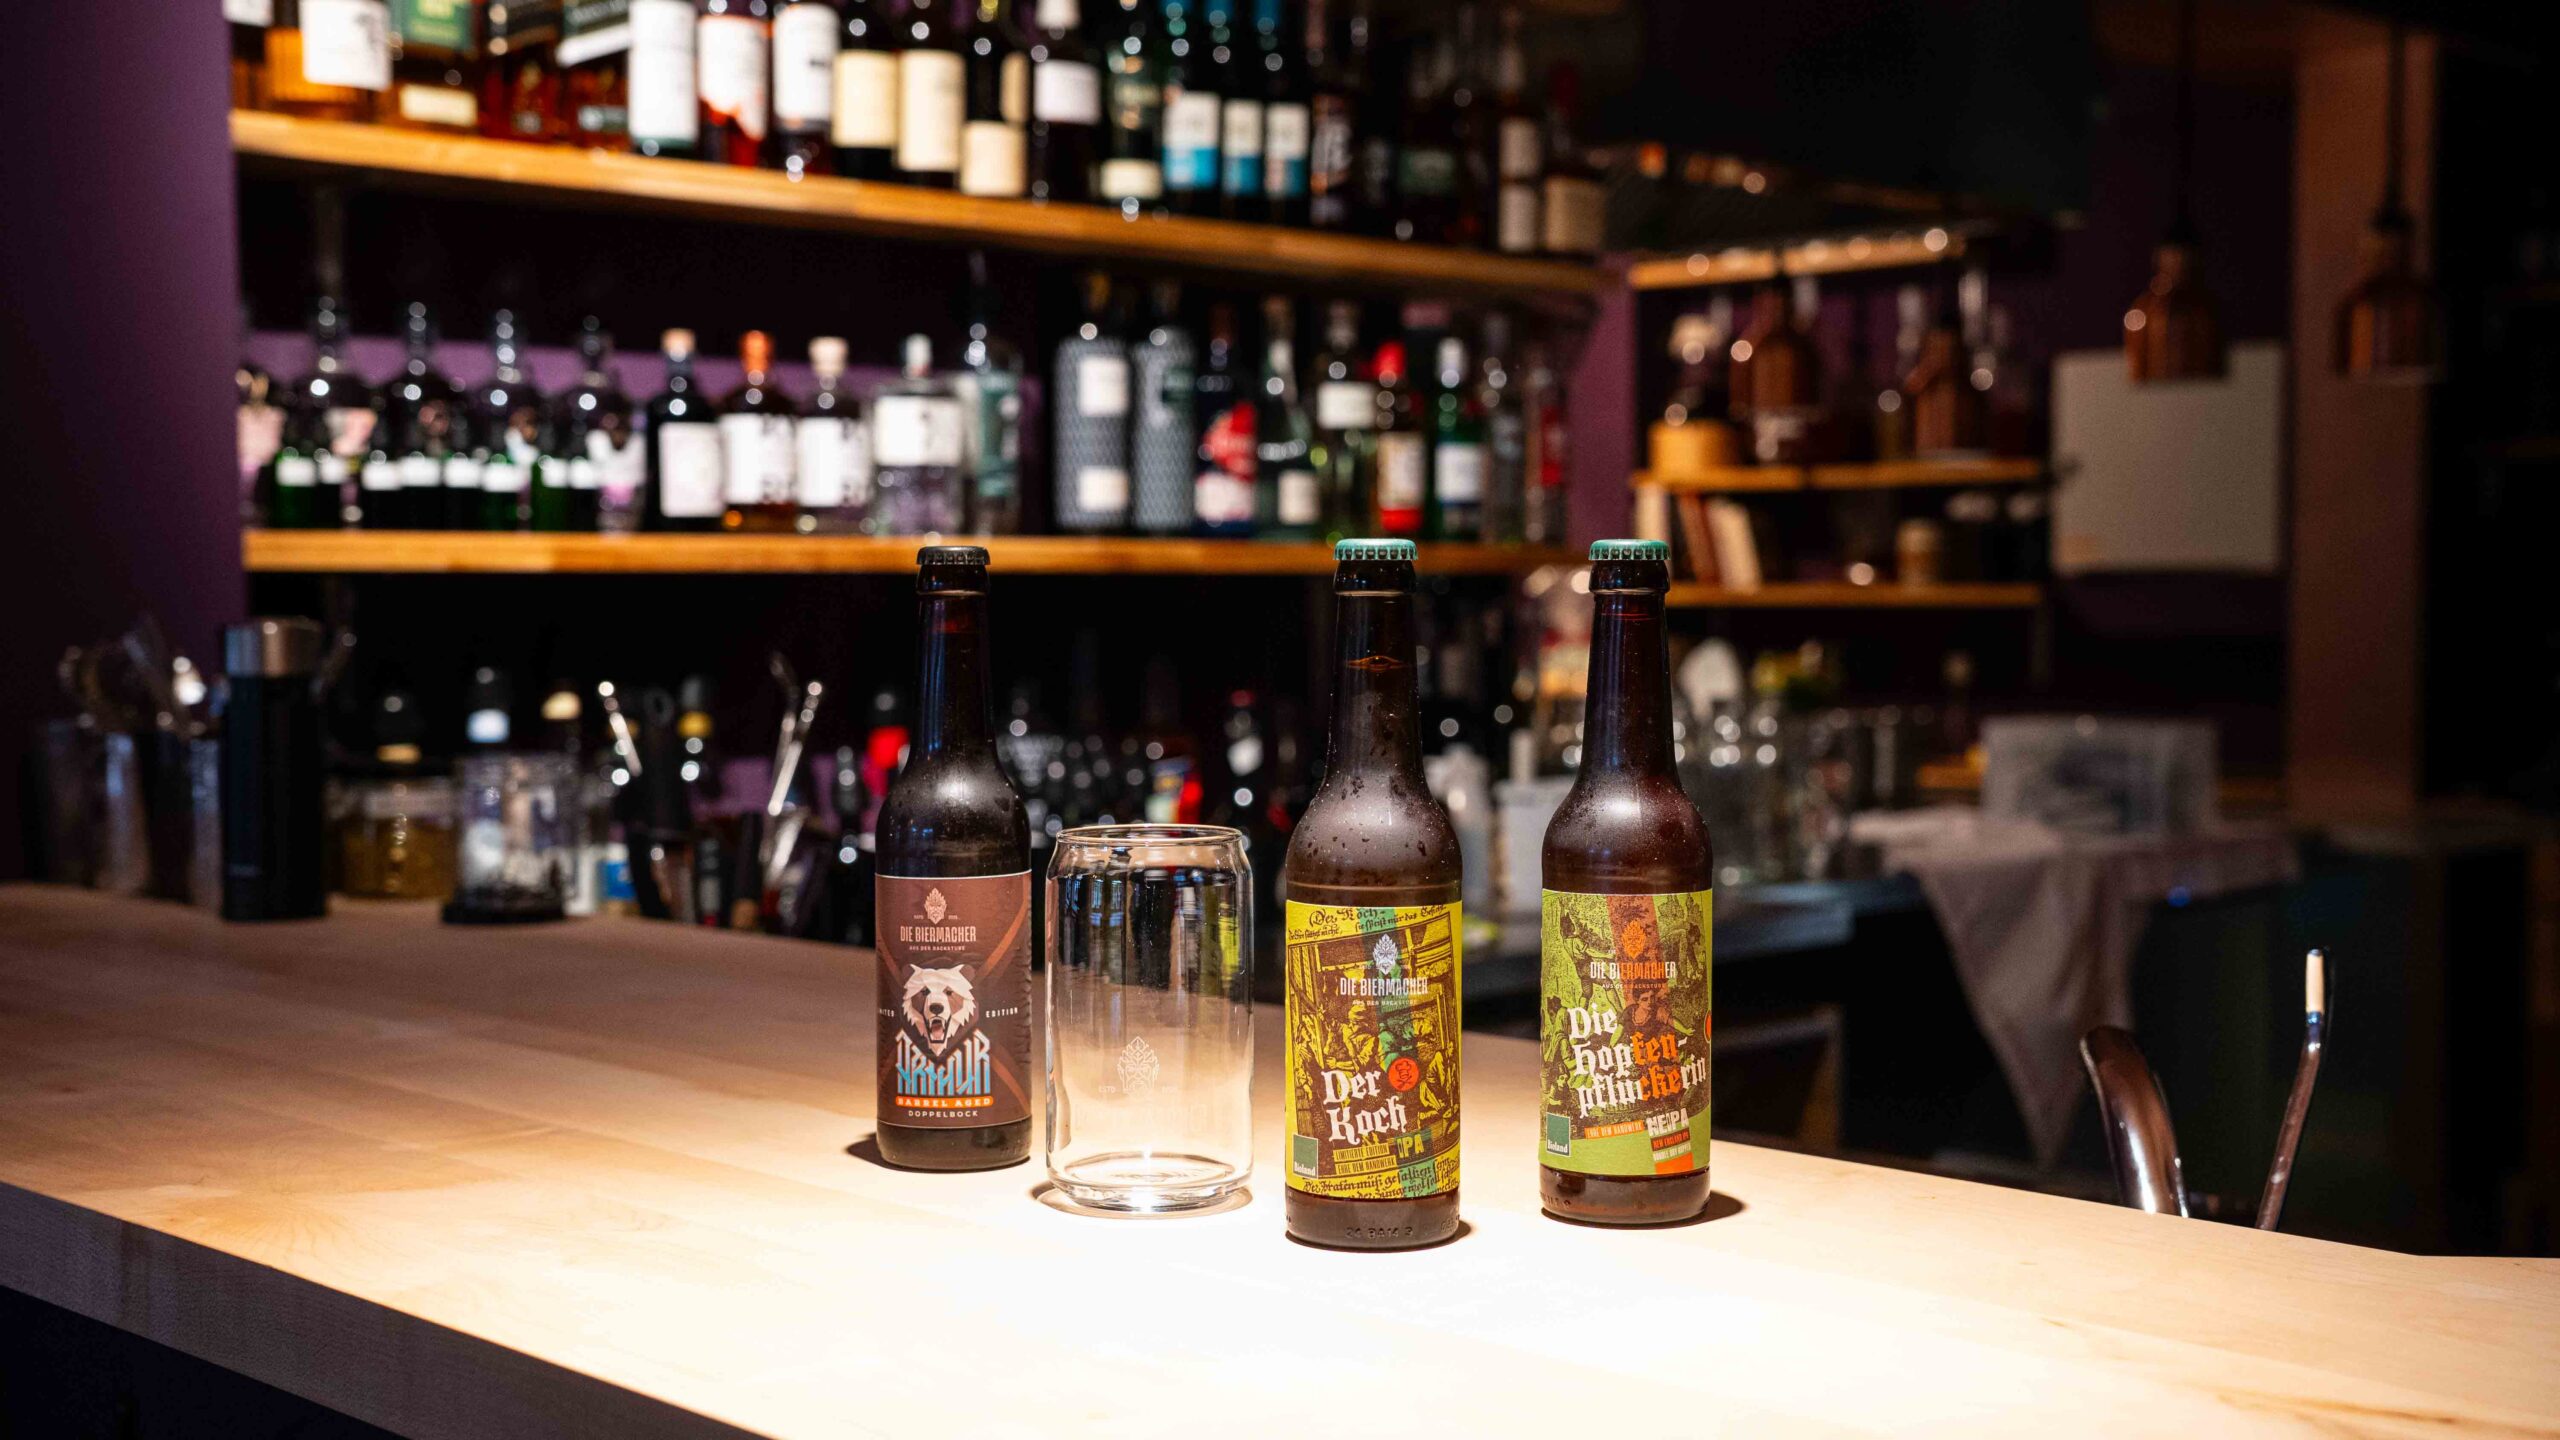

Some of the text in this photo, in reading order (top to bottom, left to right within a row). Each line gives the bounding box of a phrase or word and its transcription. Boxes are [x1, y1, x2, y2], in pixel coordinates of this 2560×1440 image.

[900, 925, 977, 942] DIE BIERMACHER
[1590, 962, 1676, 980] DIE BIERMACHER
[1340, 976, 1428, 996] DIE BIERMACHER
[985, 1006, 1018, 1018] EDITION
[1567, 1003, 1618, 1040] Die
[1320, 1070, 1381, 1105] Der
[897, 1098, 991, 1107] BARREL AGED
[908, 1110, 979, 1118] DOPPELBOCK
[1326, 1095, 1408, 1146] Koch
[1646, 1108, 1690, 1136] NEIPA
[1396, 1134, 1424, 1158] IPA
[1547, 1138, 1568, 1154] Bioland
[1294, 1161, 1316, 1176] Bioland
